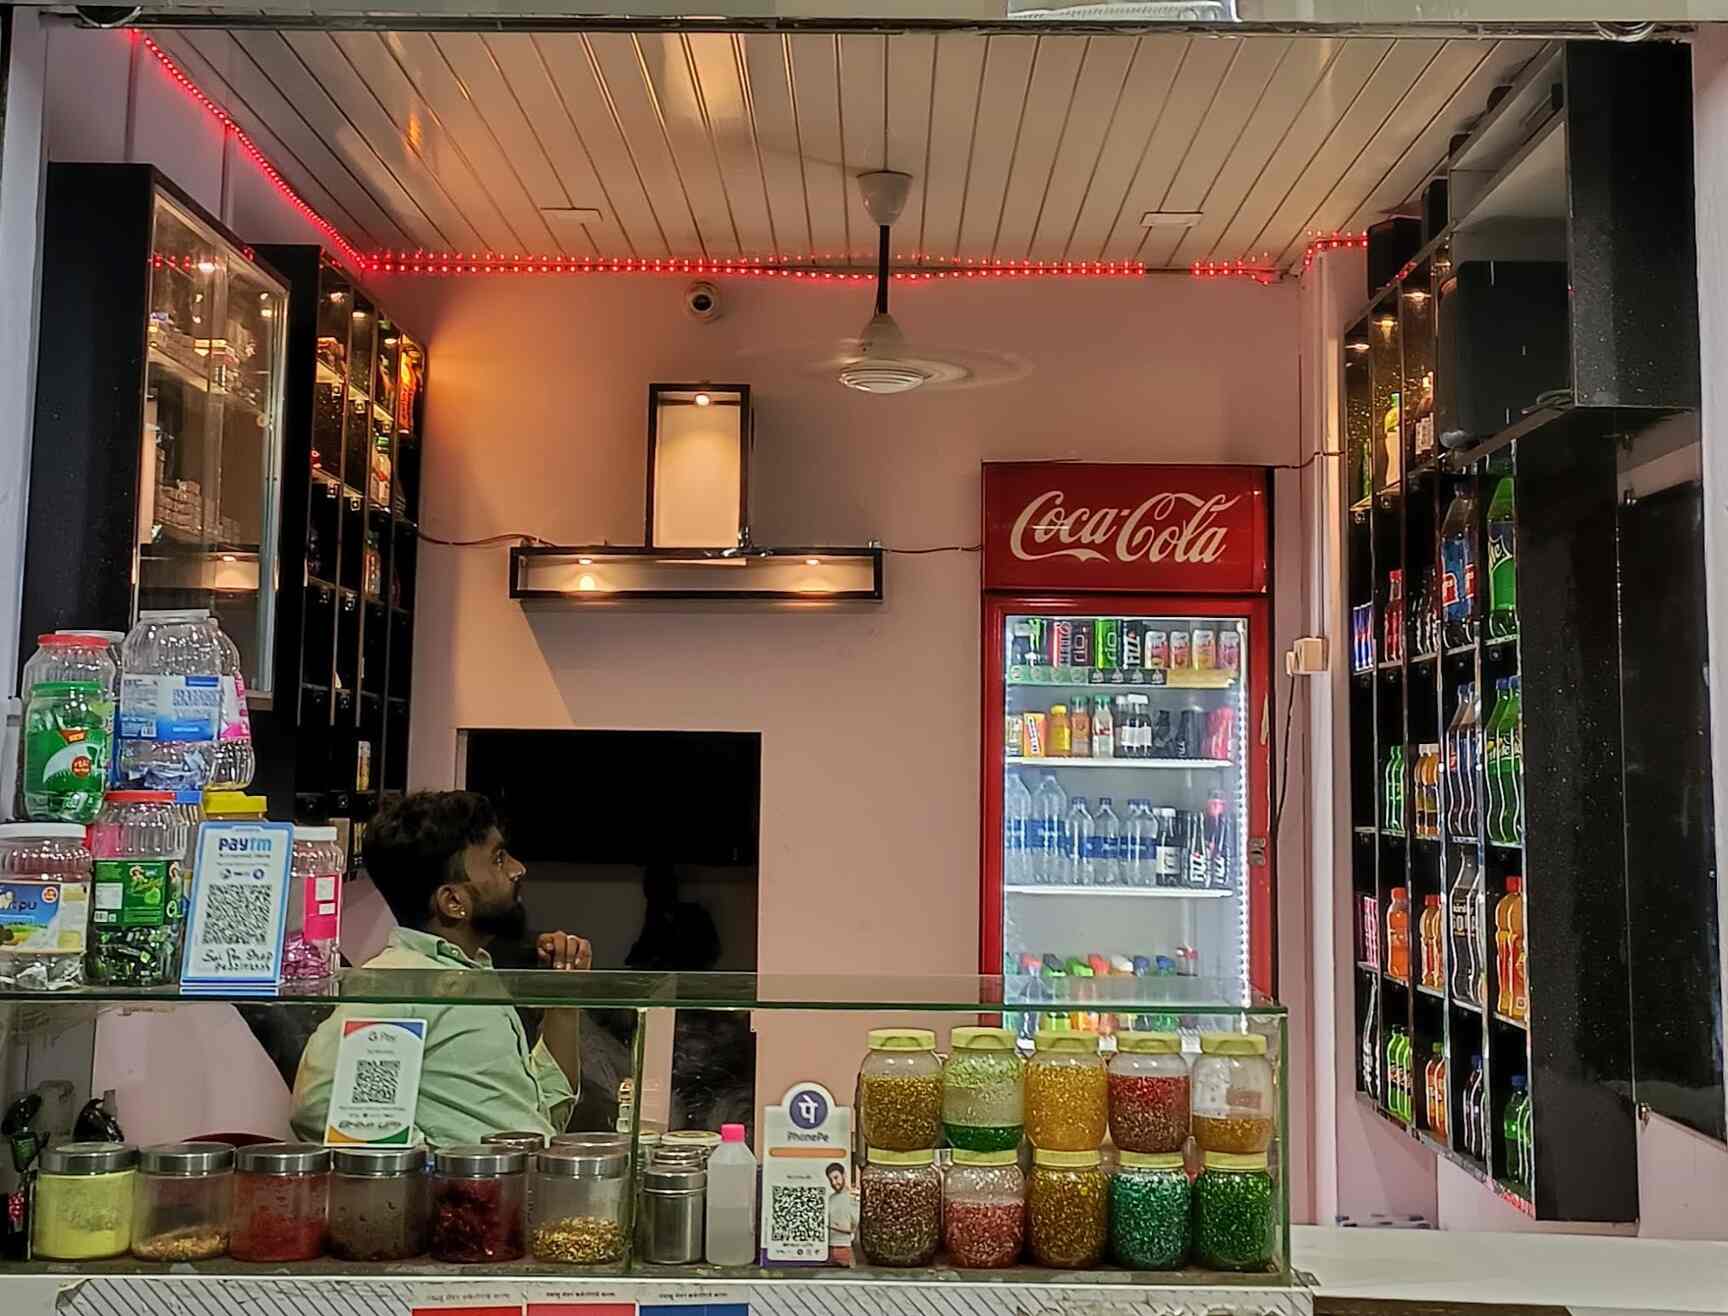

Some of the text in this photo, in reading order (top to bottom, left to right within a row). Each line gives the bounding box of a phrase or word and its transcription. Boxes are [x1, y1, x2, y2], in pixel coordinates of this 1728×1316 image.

[1010, 490, 1240, 564] Coca-Cola
[797, 1094, 819, 1124] पे
[786, 1131, 830, 1144] PhonePe
